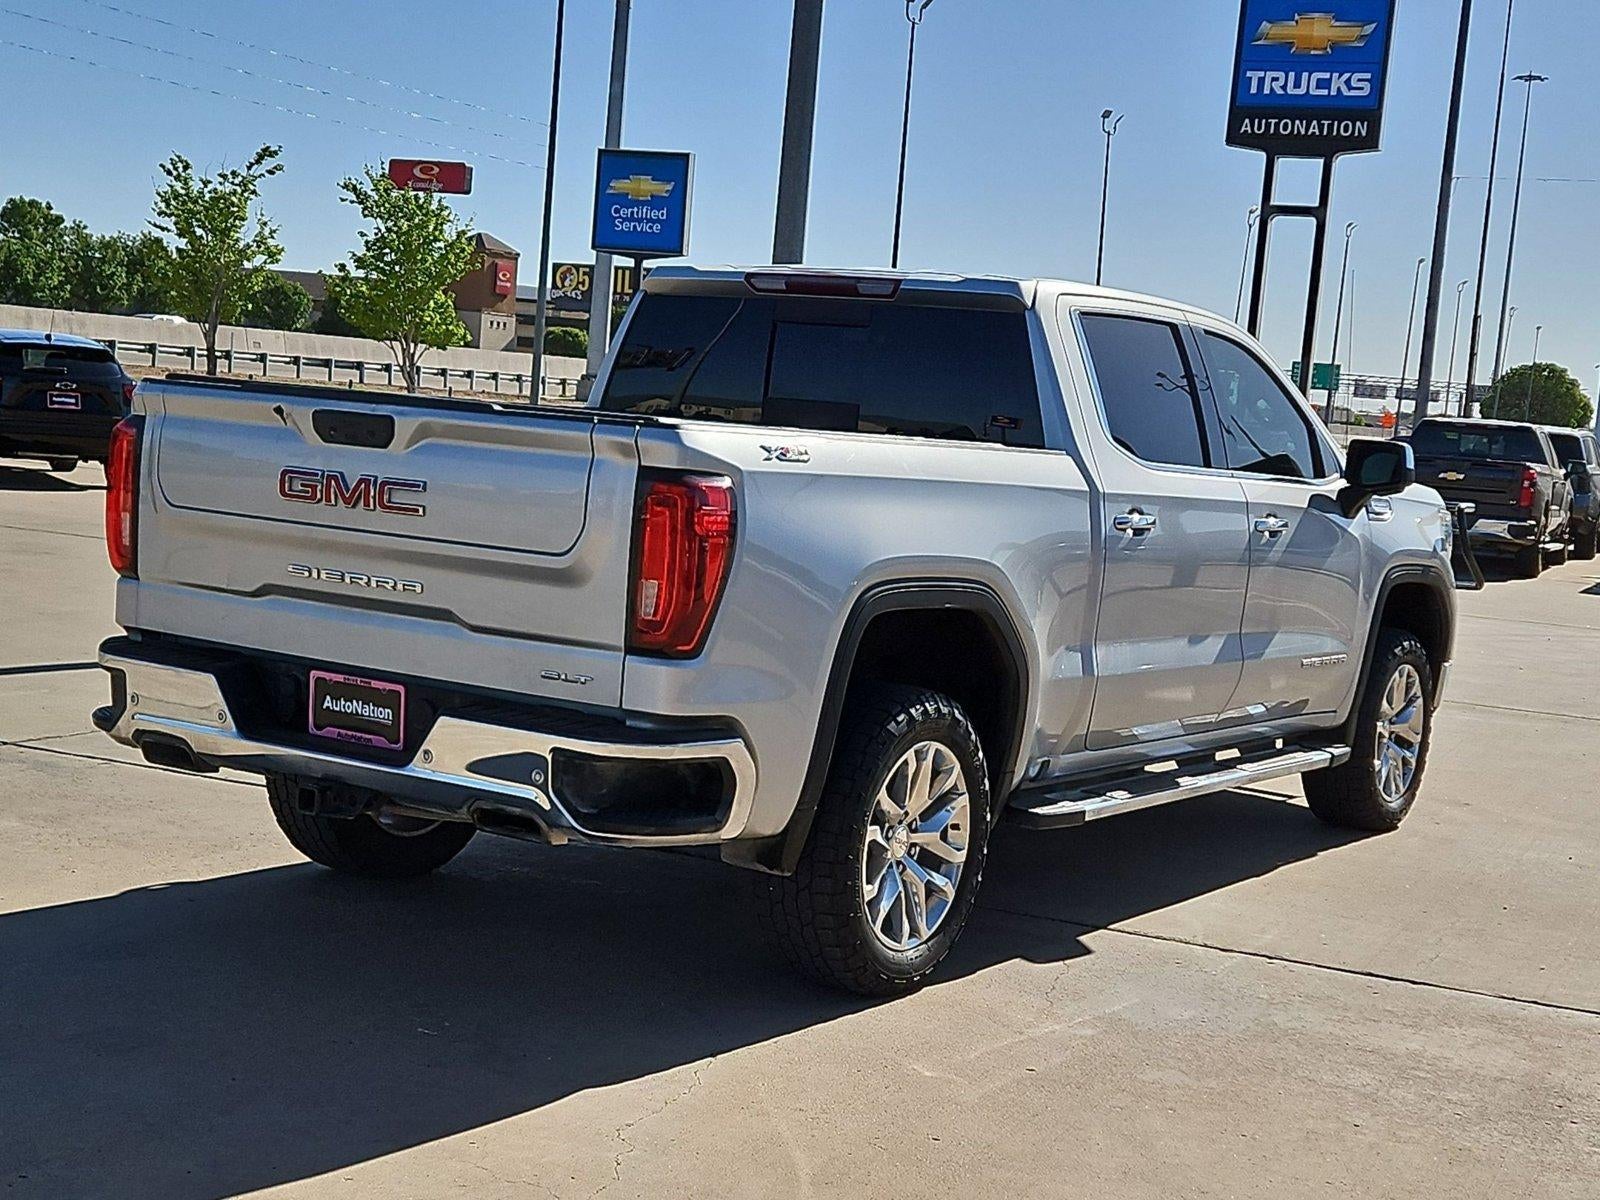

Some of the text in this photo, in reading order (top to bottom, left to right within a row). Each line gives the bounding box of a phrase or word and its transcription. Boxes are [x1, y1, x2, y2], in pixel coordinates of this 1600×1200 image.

[1246, 70, 1372, 96] TRUCKS
[1240, 118, 1368, 137] AUTONATION
[611, 204, 667, 220] Certified
[614, 218, 661, 233] Service
[278, 465, 428, 517] GMC
[287, 563, 424, 595] SIERRA
[540, 669, 594, 685] SLT
[322, 694, 393, 720] AutoNation
